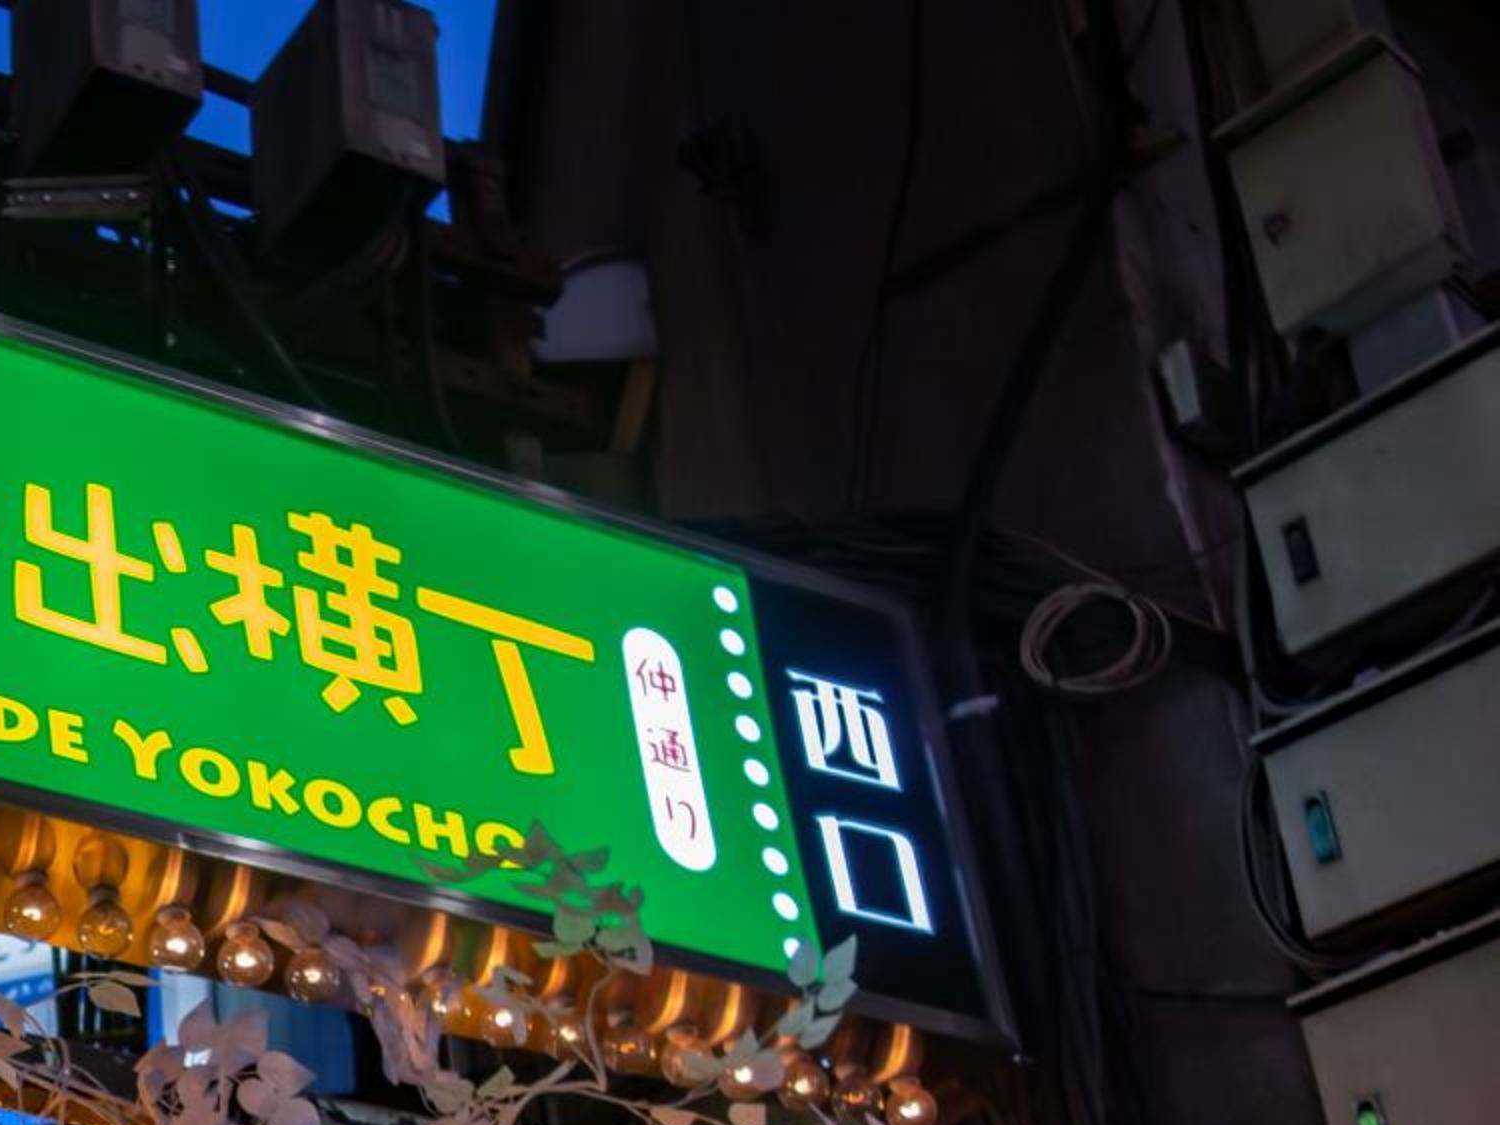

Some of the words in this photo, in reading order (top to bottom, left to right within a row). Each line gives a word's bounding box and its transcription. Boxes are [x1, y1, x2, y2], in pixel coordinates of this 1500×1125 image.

[112, 719, 527, 869] YOKOCHO
[635, 657, 698, 841] 仲通り
[784, 667, 936, 936] 西口
